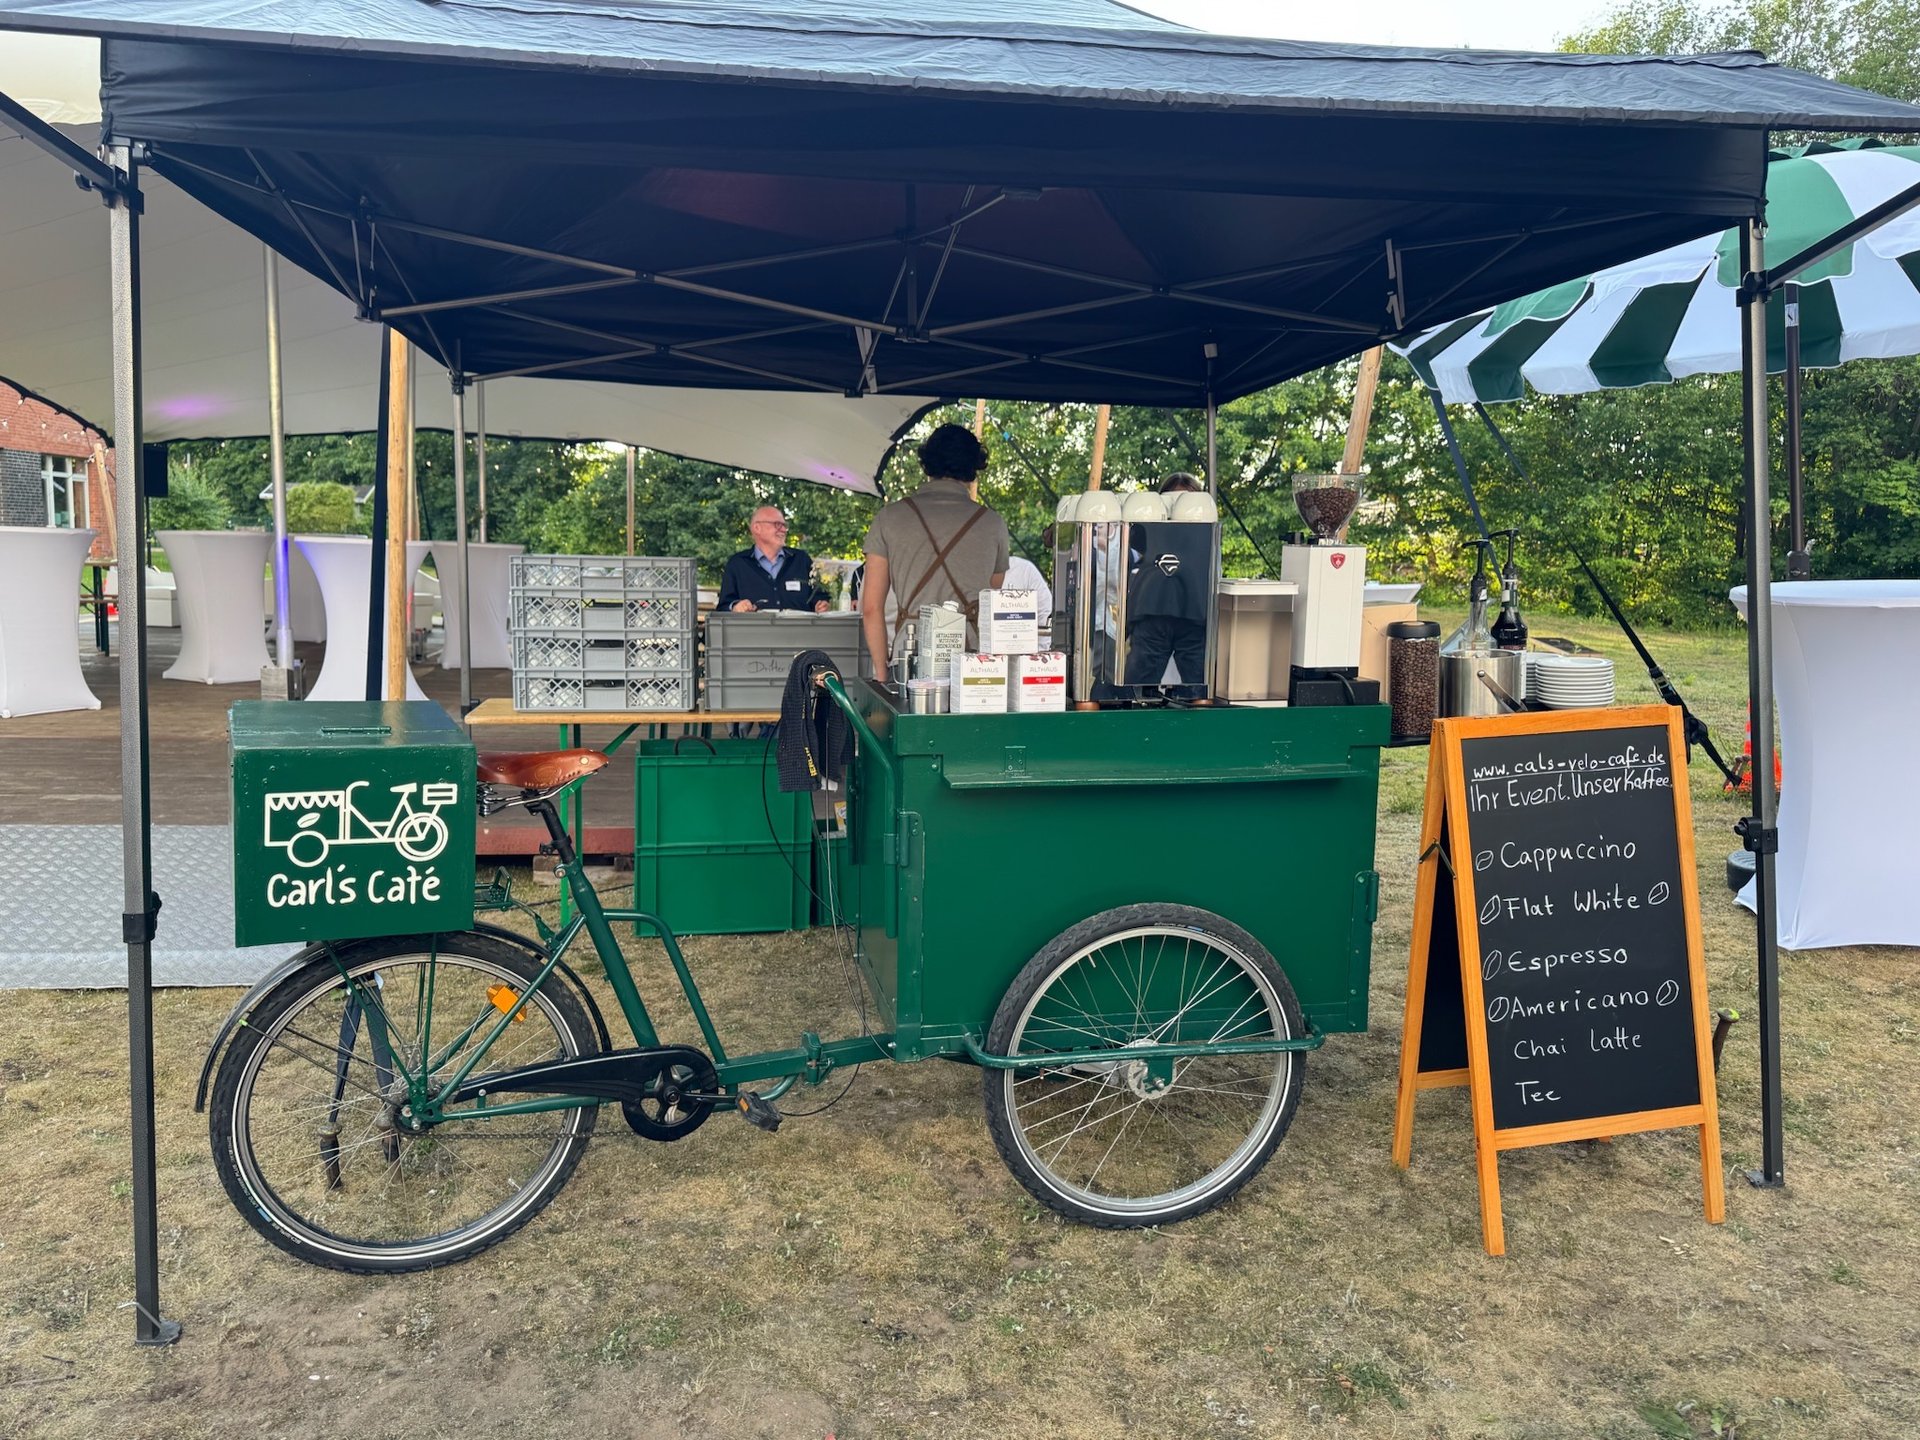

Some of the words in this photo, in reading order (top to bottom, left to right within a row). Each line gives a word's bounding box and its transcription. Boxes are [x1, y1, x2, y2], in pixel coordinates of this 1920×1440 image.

[1470, 786, 1500, 812] Ihr
[1500, 835, 1636, 872] Cappuccino
[1503, 895, 1554, 919] Flat
[1574, 883, 1640, 913] White
[1508, 948, 1628, 976] Espresso
[1510, 990, 1648, 1019] Americano
[1514, 1038, 1567, 1059] Chai
[1515, 1081, 1561, 1105] Tee
